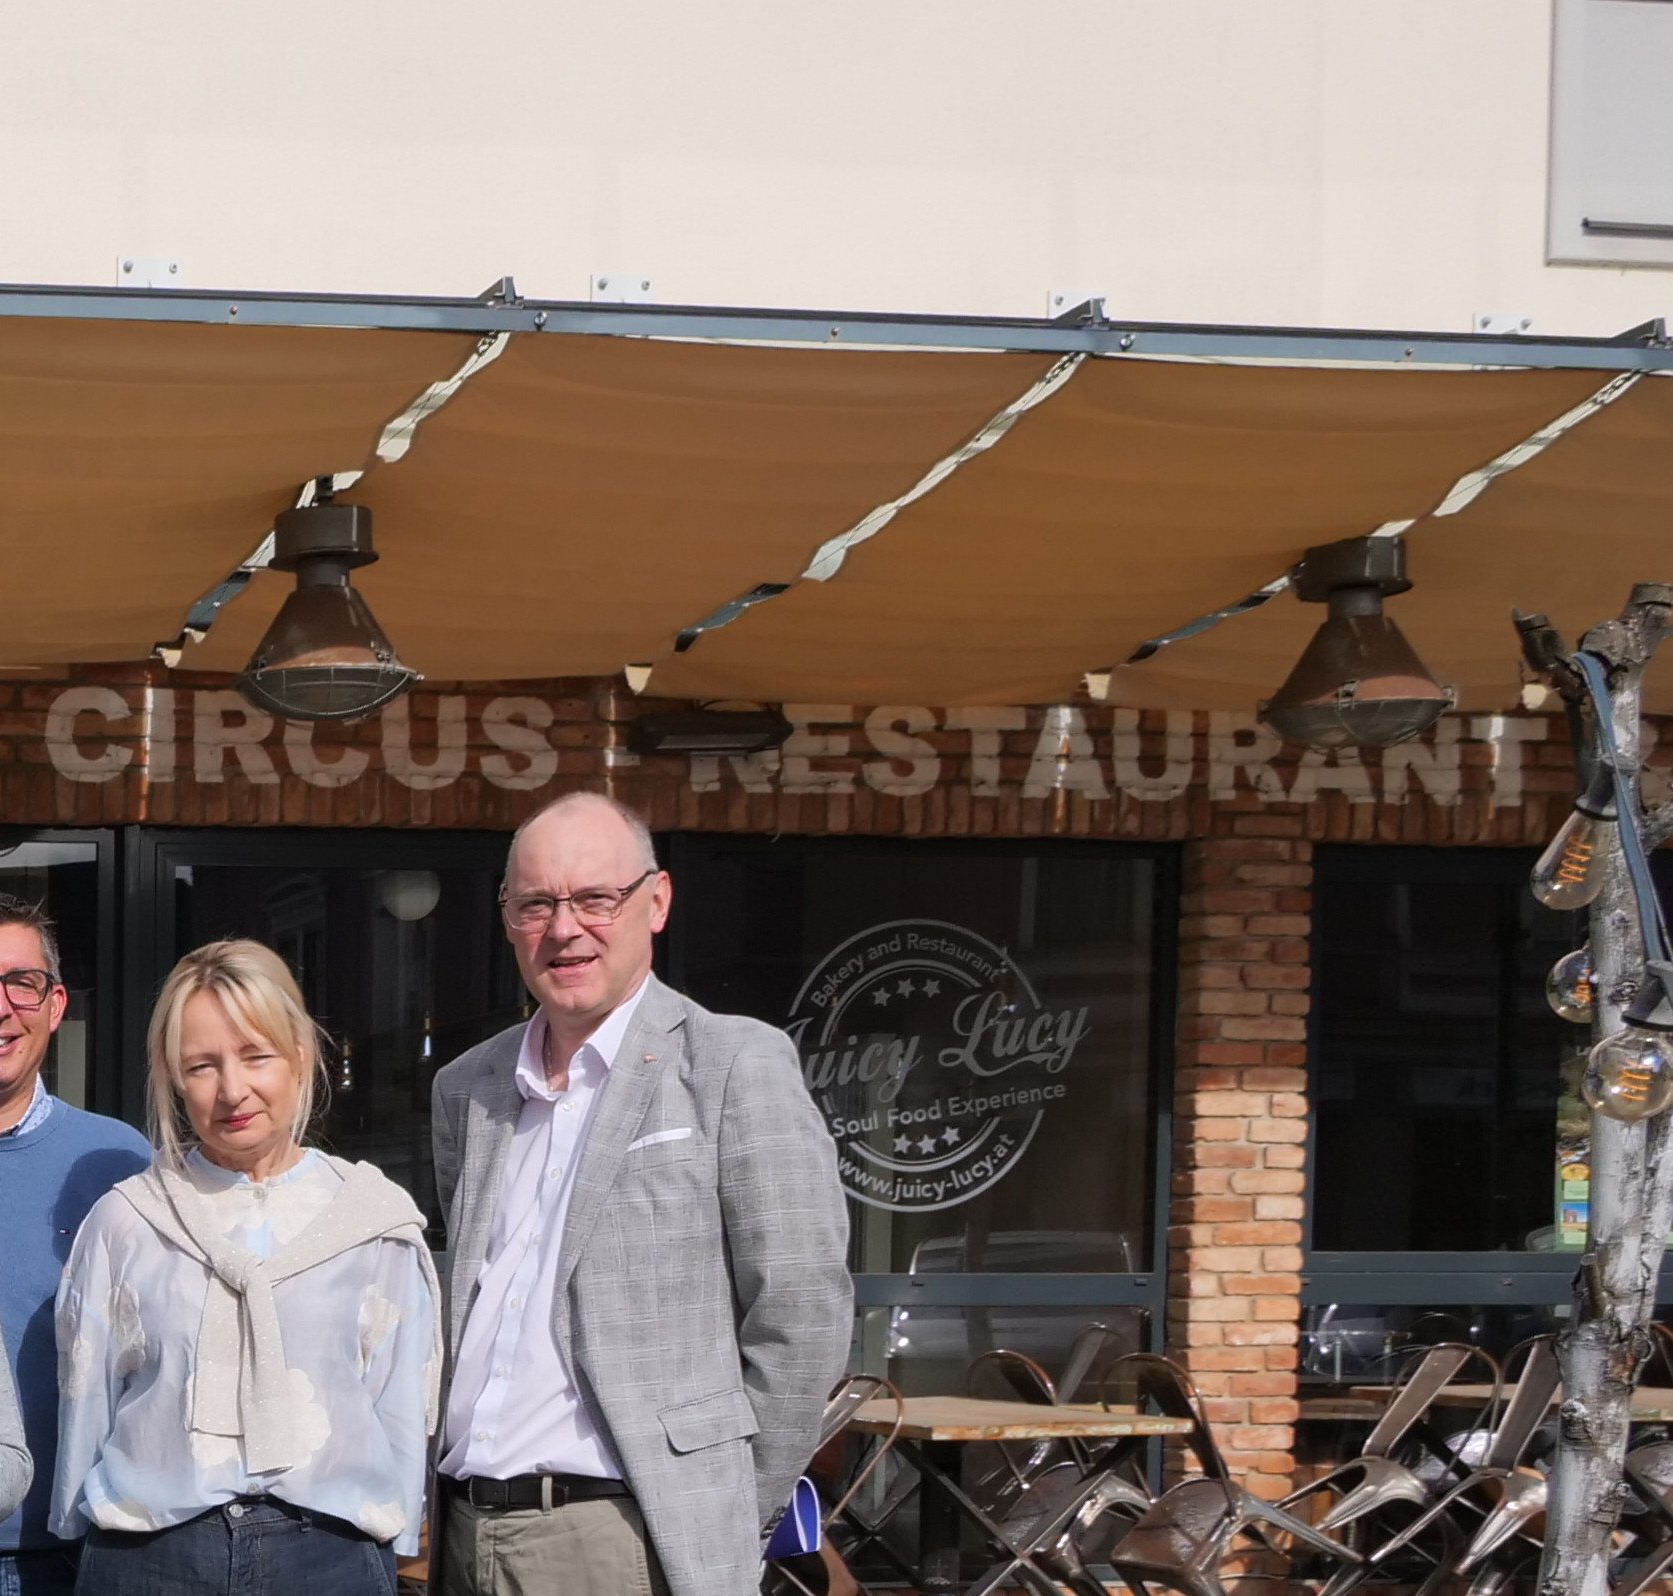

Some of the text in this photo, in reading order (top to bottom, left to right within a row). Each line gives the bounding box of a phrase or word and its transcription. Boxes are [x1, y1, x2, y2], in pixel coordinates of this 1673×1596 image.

[44, 686, 558, 791] CIRCUS
[810, 933, 1000, 1009] Bakery and Restaurant
[939, 991, 1092, 1077] Lucy
[832, 1082, 1067, 1138] Soul Food Experience
[839, 1133, 1015, 1201] www.juicy-lucy.at
